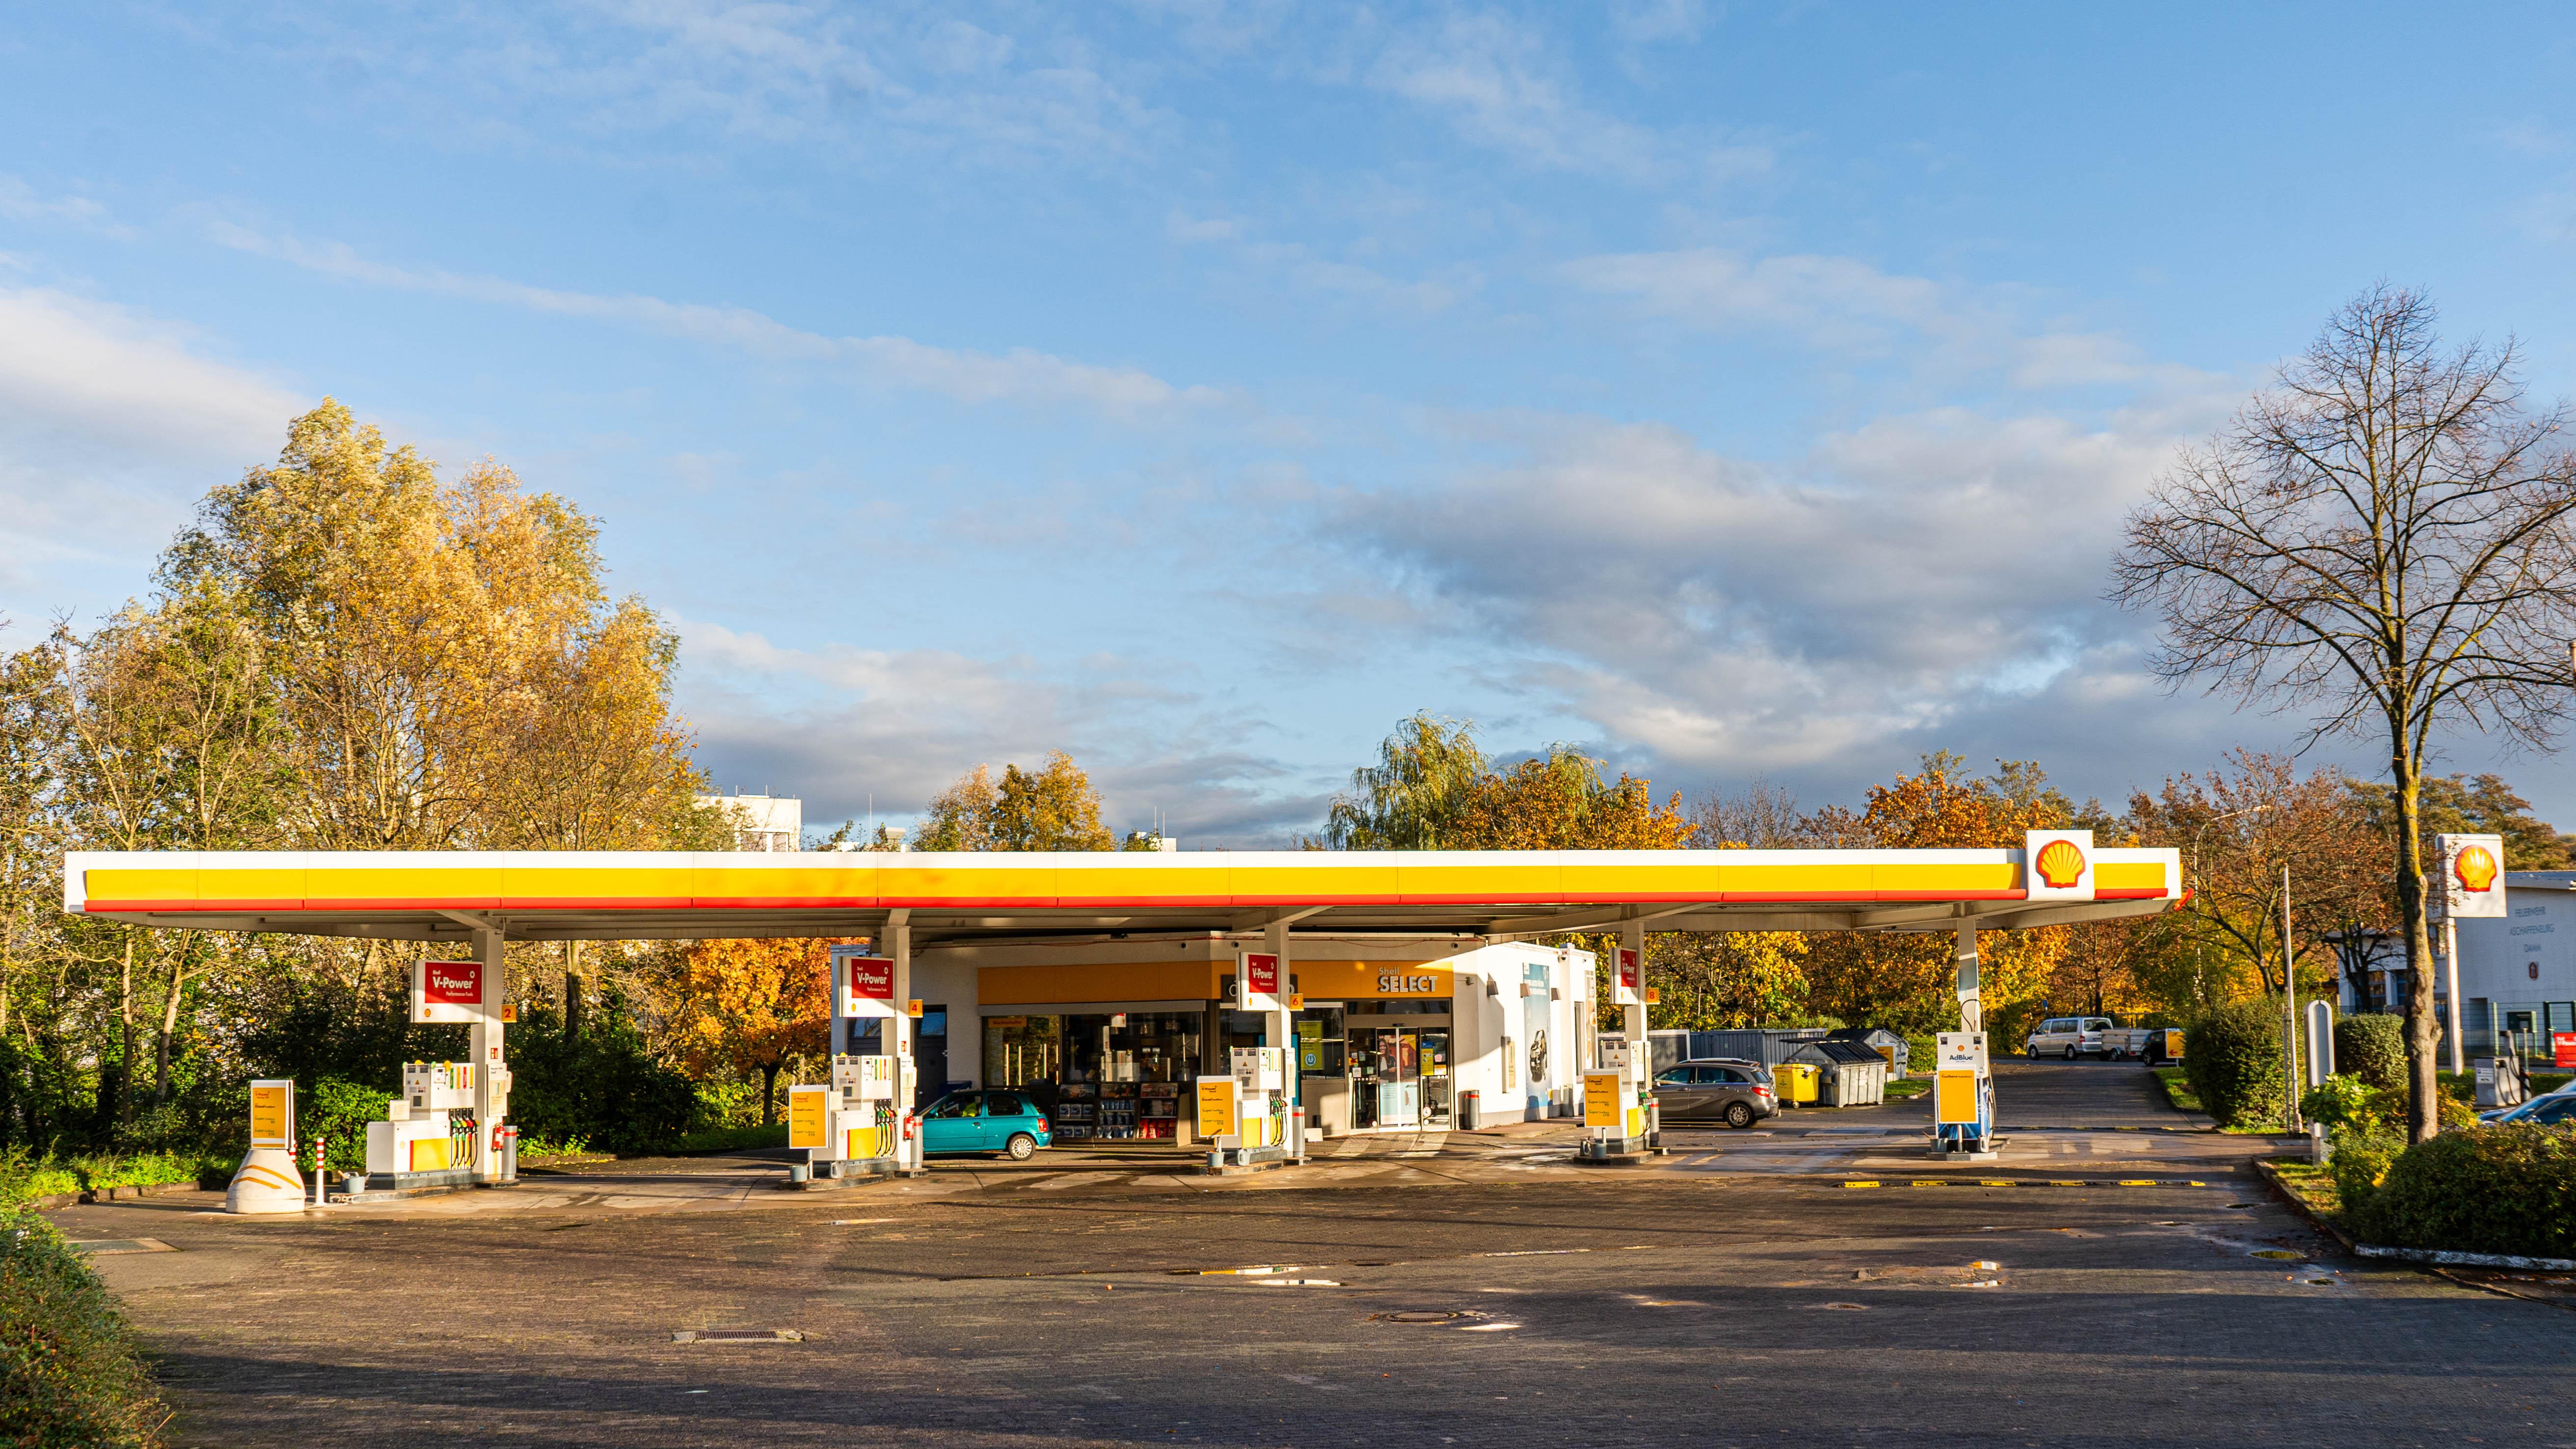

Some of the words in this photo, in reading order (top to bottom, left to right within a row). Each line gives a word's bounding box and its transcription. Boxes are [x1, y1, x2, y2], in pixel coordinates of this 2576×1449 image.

[2515, 906, 2546, 918] FEUERWEHR
[2509, 923, 2555, 936] ASCHAFFENBURG
[2524, 944, 2542, 952] DAMM
[1252, 968, 1273, 979] V-Power
[1379, 966, 1399, 975] Shell
[432, 976, 473, 989] V-Power
[857, 973, 887, 984] V-Power
[1379, 975, 1438, 993] SELECT
[504, 1008, 511, 1018] 2
